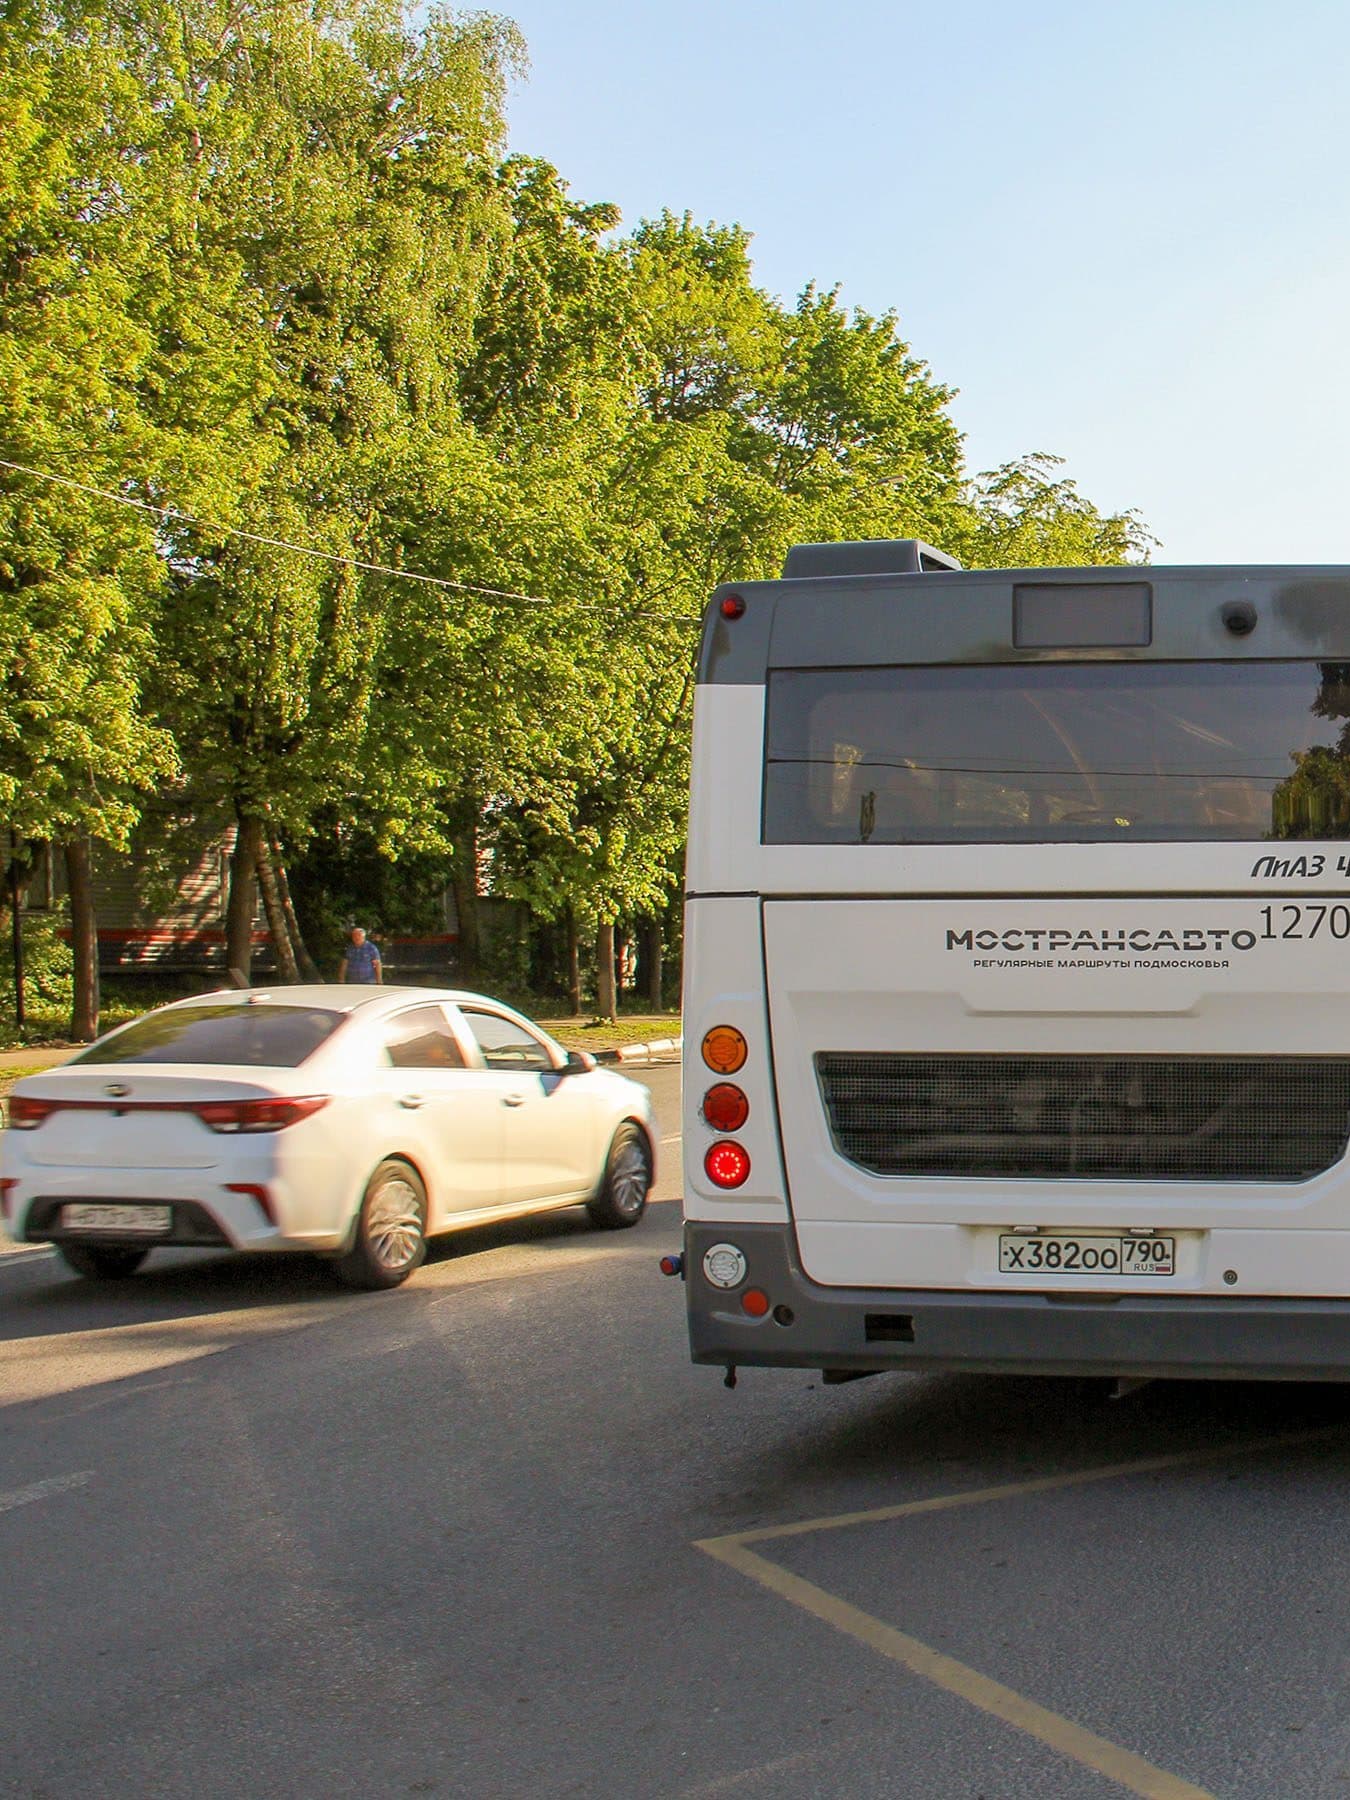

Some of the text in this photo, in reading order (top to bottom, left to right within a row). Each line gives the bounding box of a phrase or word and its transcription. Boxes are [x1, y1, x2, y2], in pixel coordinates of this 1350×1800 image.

[1250, 855, 1327, 878] ЛиАЗ
[945, 929, 1257, 951] МОСТРАНСАВТО
[973, 959, 1230, 968] РЕГУЛЯРНЫЕ МАРШРУТЫ ПОДМОСКОВЬЯ
[1134, 1263, 1154, 1272] RUS
